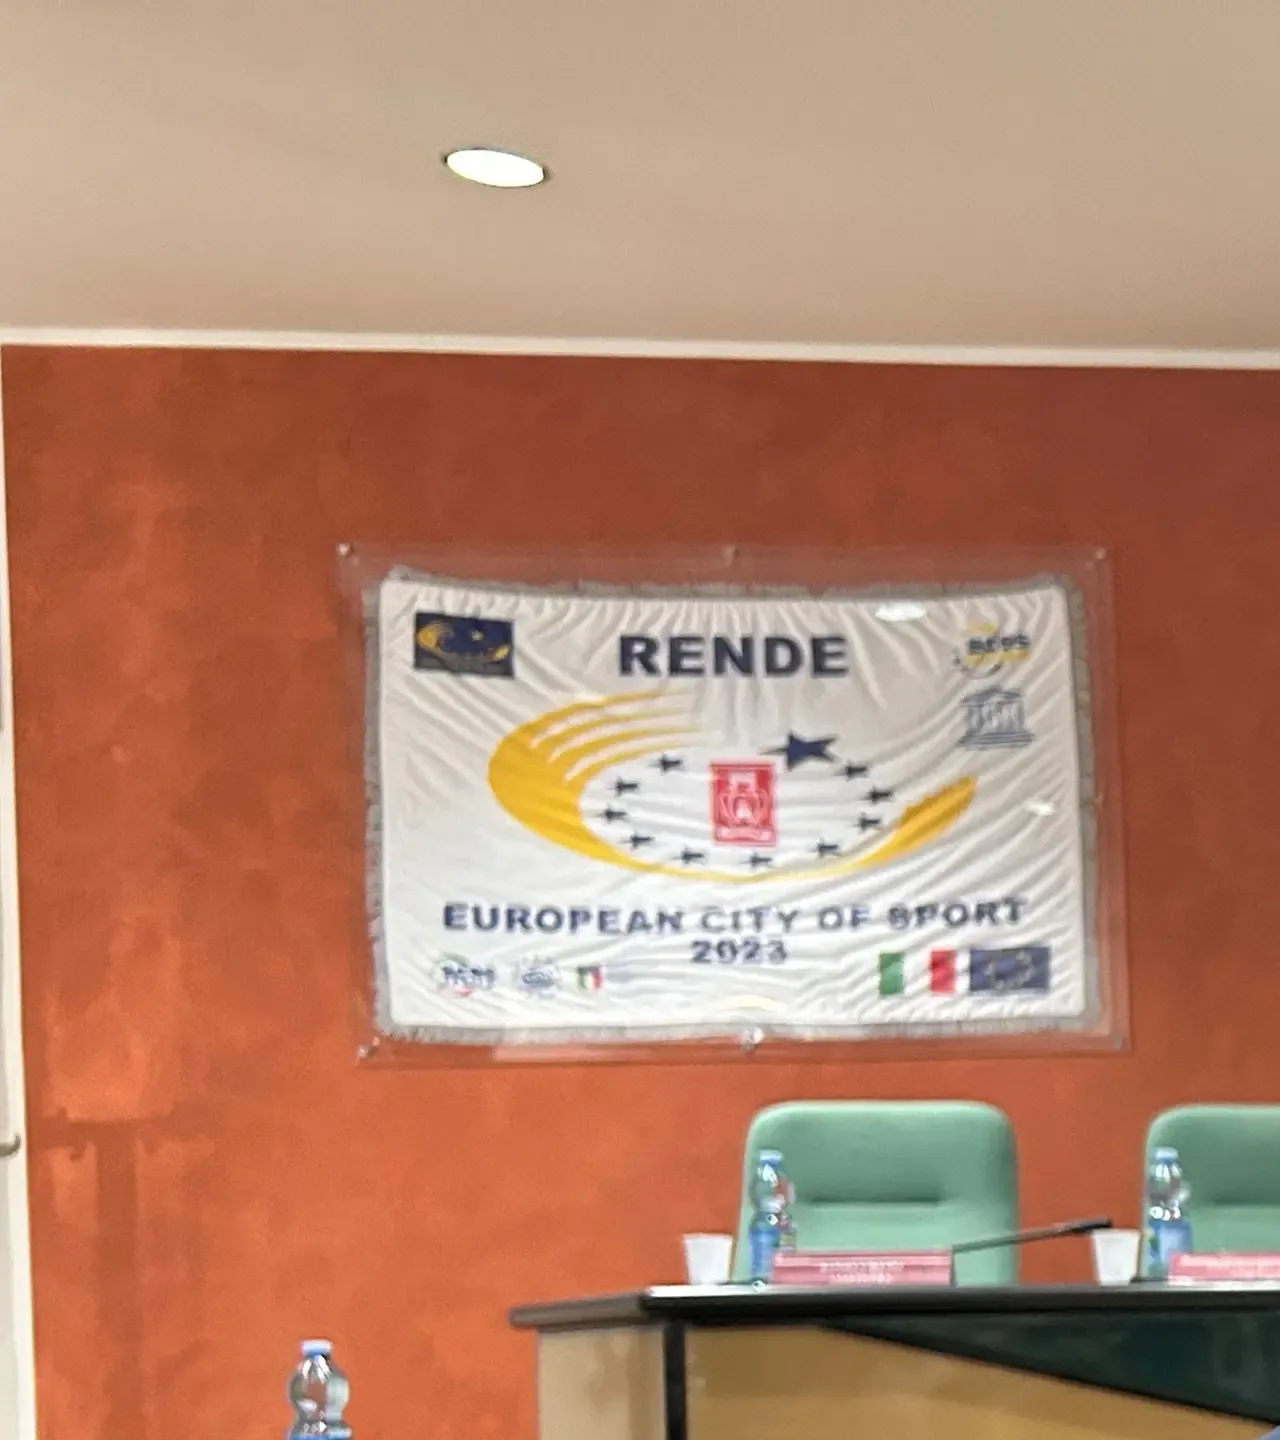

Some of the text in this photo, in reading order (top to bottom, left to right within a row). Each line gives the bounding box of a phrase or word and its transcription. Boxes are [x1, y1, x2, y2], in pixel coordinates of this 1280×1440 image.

[619, 635, 849, 677] RENDE
[443, 896, 1027, 934] EUROPEAN CITY OF SPORT
[690, 939, 788, 965] 2023
